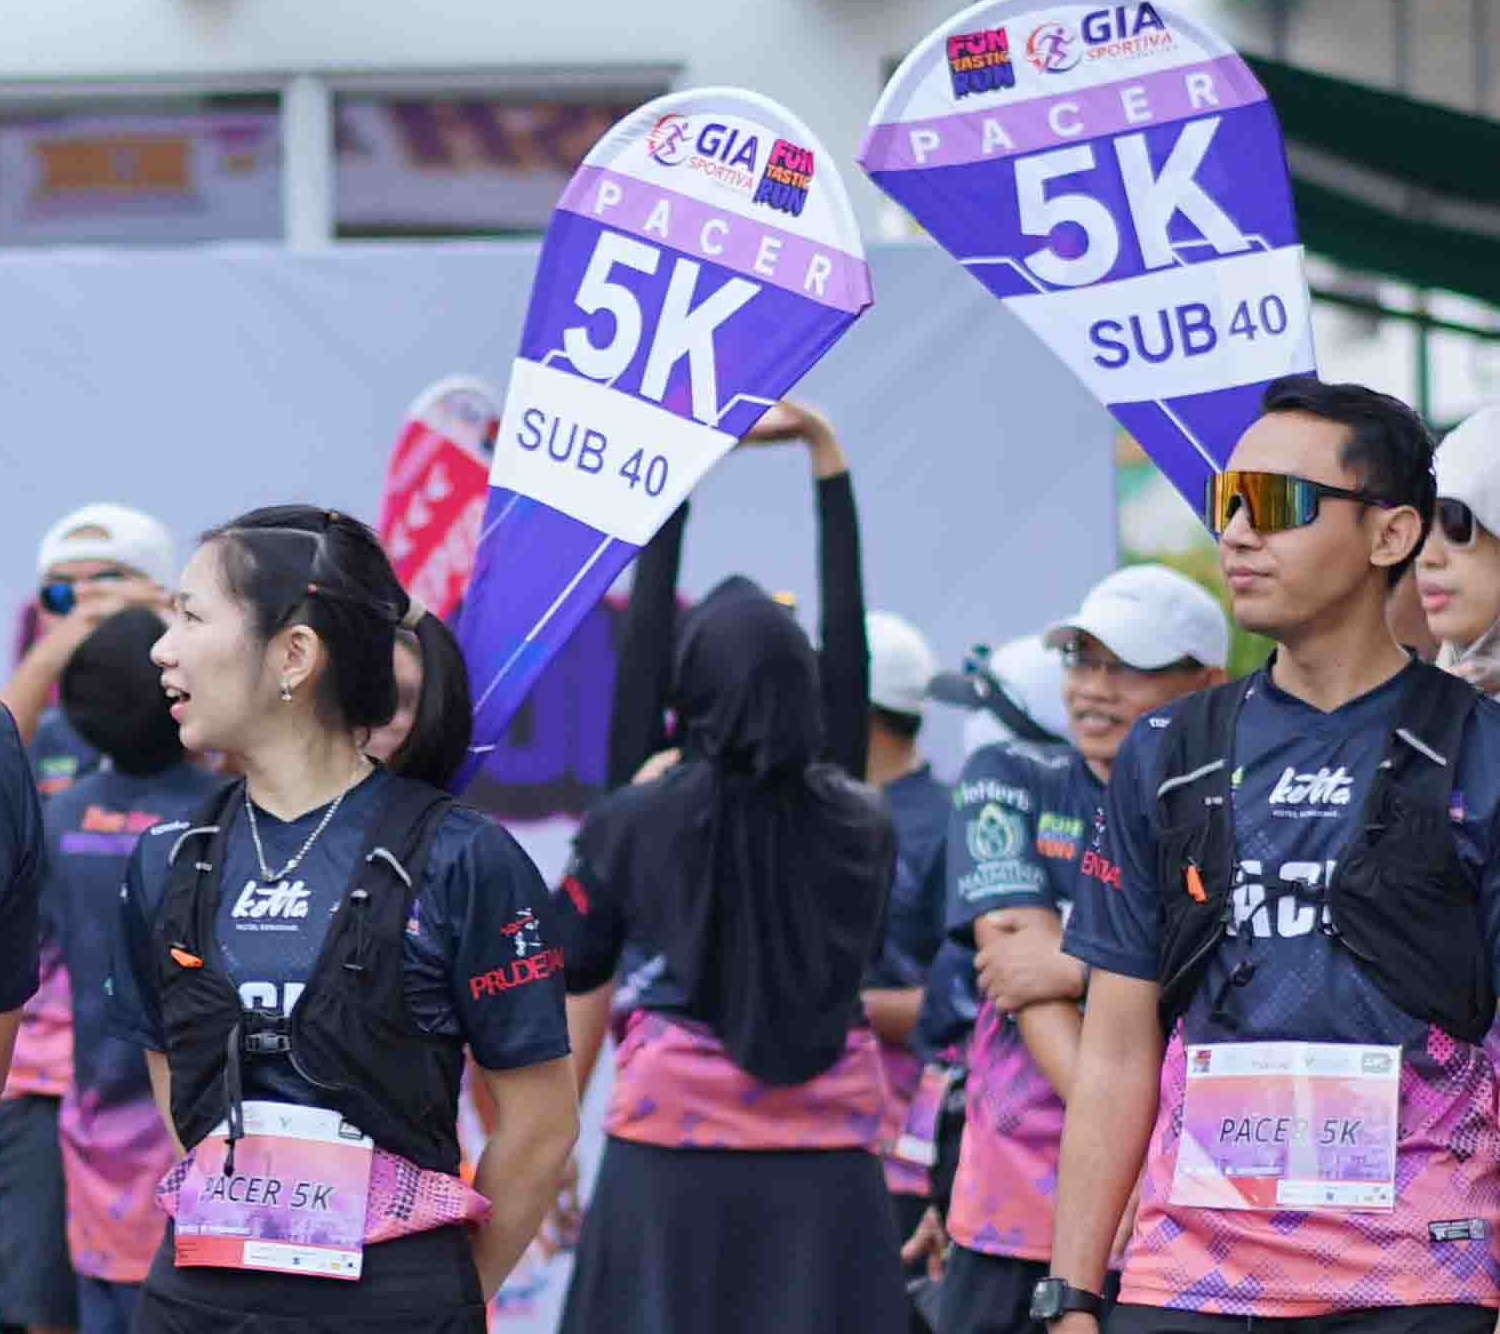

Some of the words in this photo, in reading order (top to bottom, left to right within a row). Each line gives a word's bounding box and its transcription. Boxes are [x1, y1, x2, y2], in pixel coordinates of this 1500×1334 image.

[1081, 1, 1166, 45] GIA
[696, 123, 759, 172] GIA
[909, 71, 1221, 164] PACER
[594, 180, 833, 297] PACER
[1013, 116, 1252, 287] 5K
[563, 231, 761, 428] 5K
[1089, 302, 1218, 369] SUB
[1230, 294, 1288, 341] 40
[516, 408, 606, 476] SUB
[619, 450, 670, 497] 40
[1320, 1119, 1362, 1145] 5K
[291, 1182, 333, 1210] 5K
